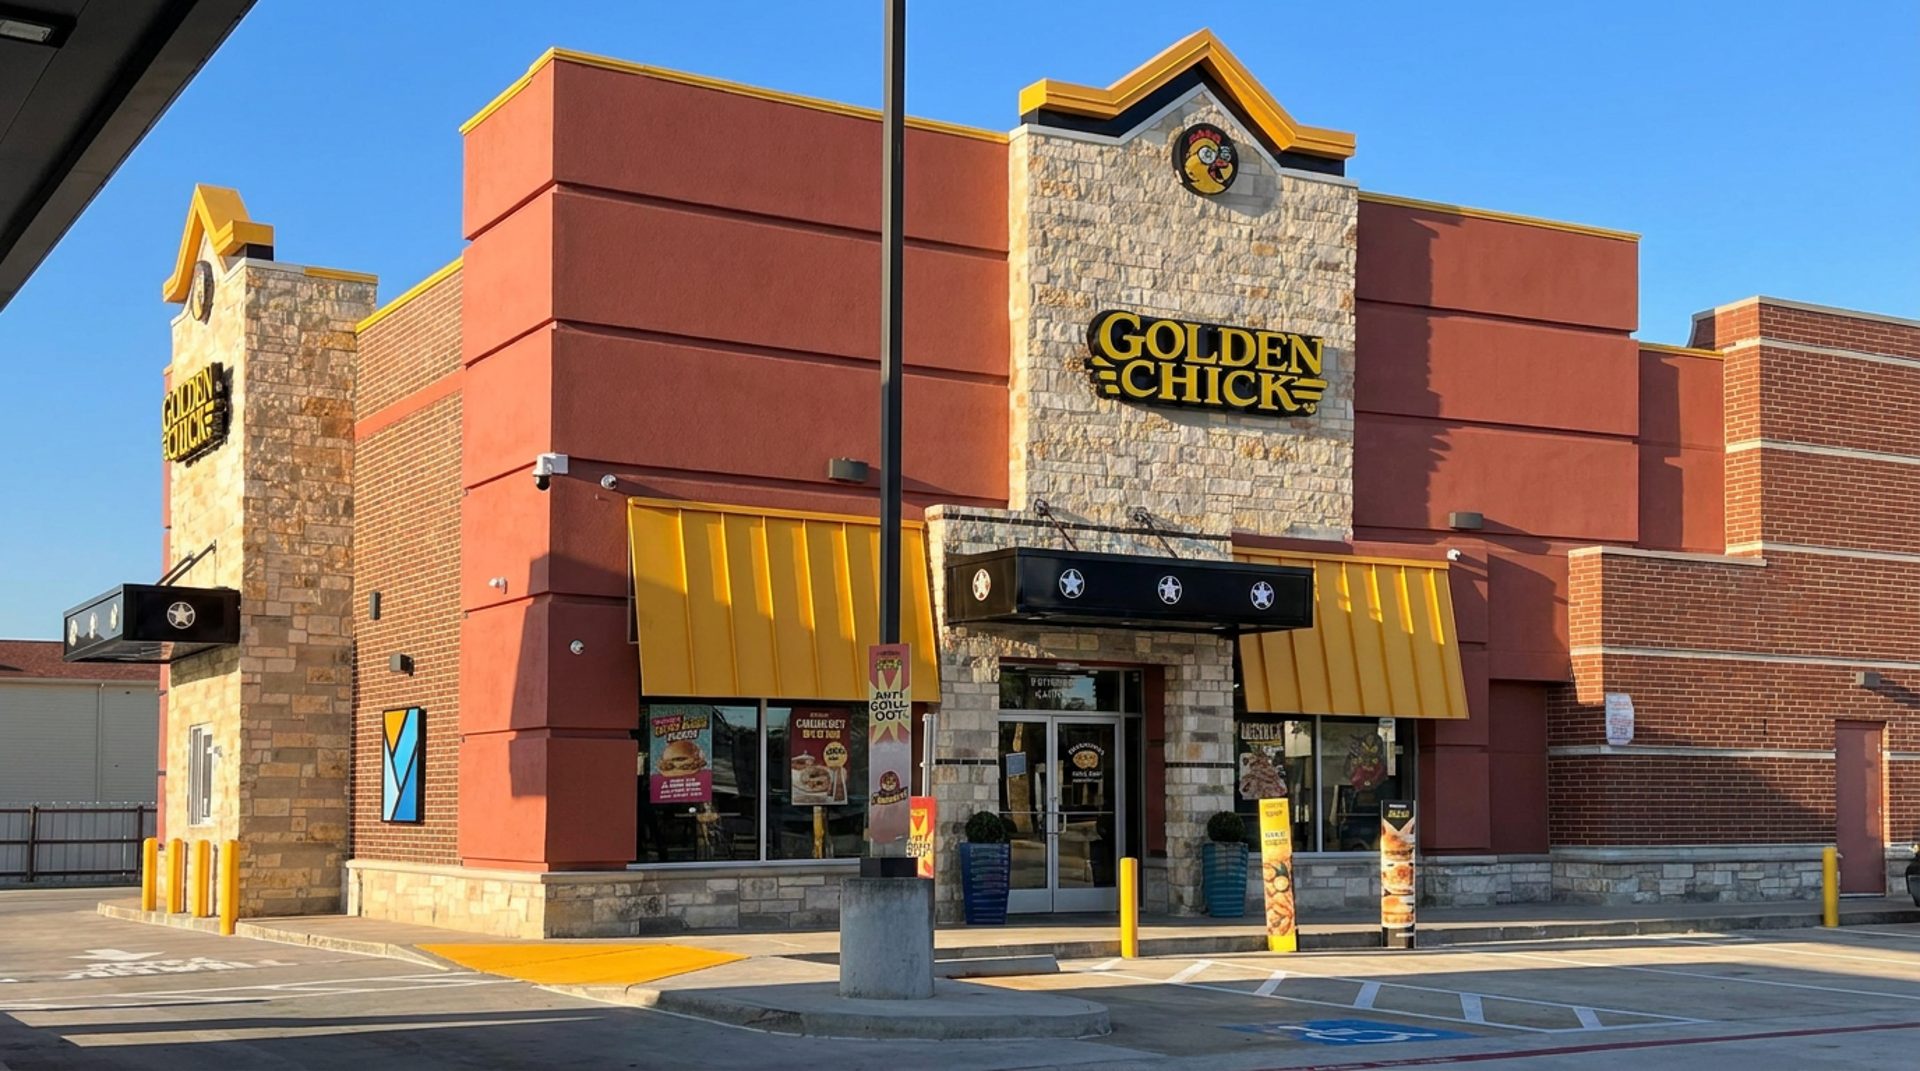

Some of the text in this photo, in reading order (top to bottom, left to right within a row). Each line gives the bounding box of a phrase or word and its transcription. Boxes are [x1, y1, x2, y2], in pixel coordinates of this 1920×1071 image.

[1099, 311, 1324, 376] GOLDEN
[162, 366, 214, 432] GOLDEN
[1121, 360, 1300, 412] CHICK
